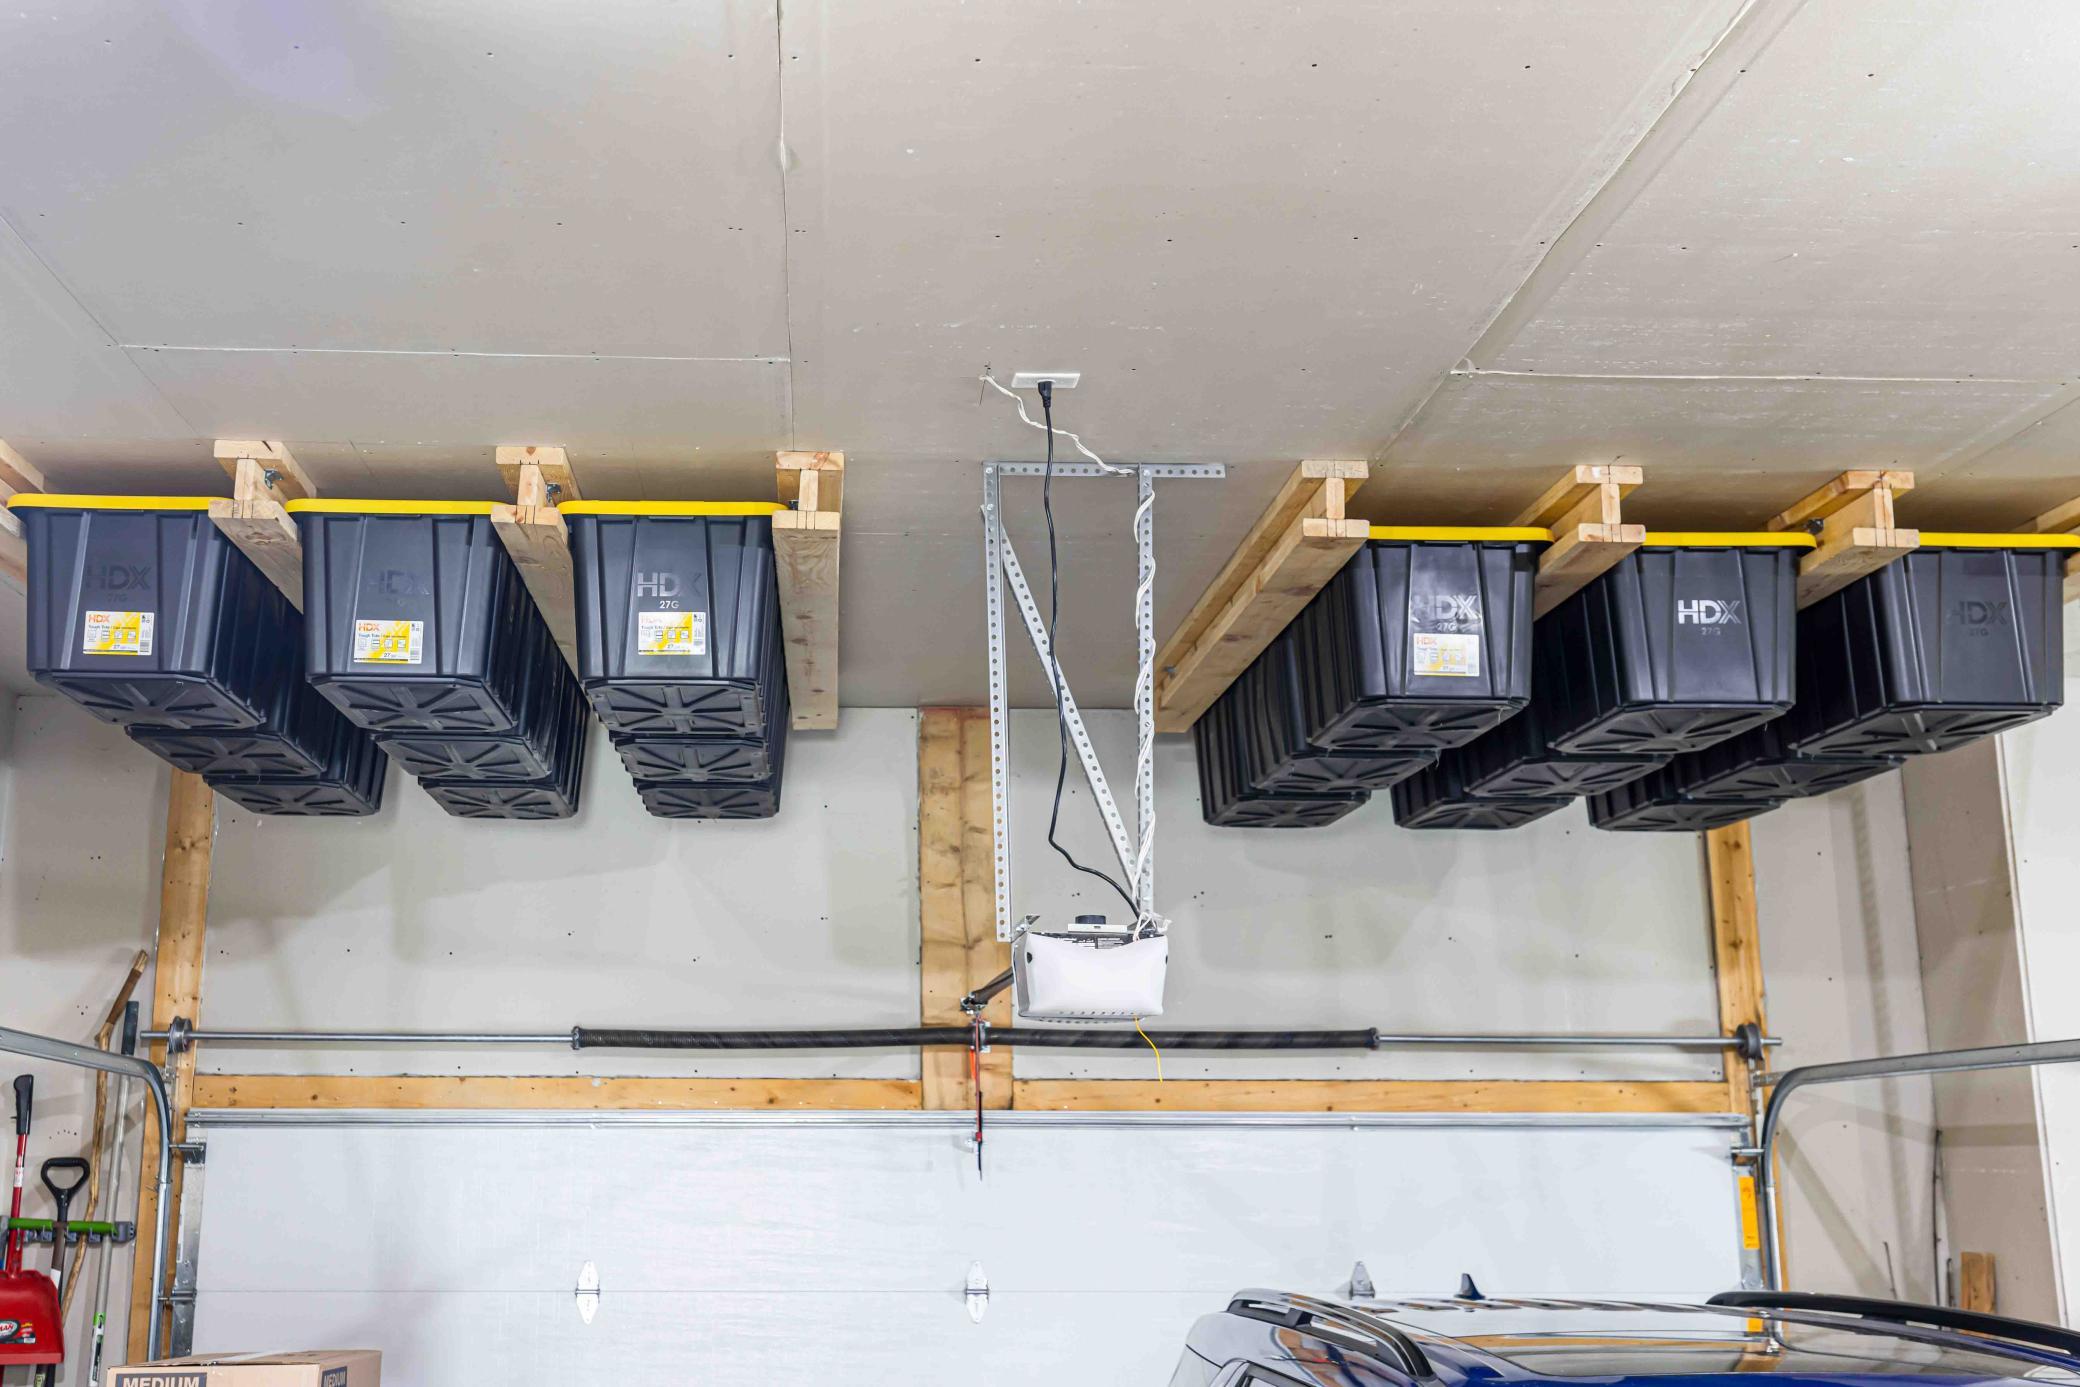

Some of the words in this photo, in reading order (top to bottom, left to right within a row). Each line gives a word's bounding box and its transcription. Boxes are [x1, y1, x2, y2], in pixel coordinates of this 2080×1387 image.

[86, 565, 151, 590] HDX
[637, 572, 702, 597] HDX
[659, 600, 680, 609] 27G
[1413, 595, 1478, 619] HDX
[1678, 600, 1741, 624] HDX
[1944, 600, 2008, 625] HDX
[88, 614, 110, 623] HDX
[358, 623, 380, 632] HDX
[1701, 627, 1721, 636] 27G
[123, 1376, 200, 1387] MEDIUM
